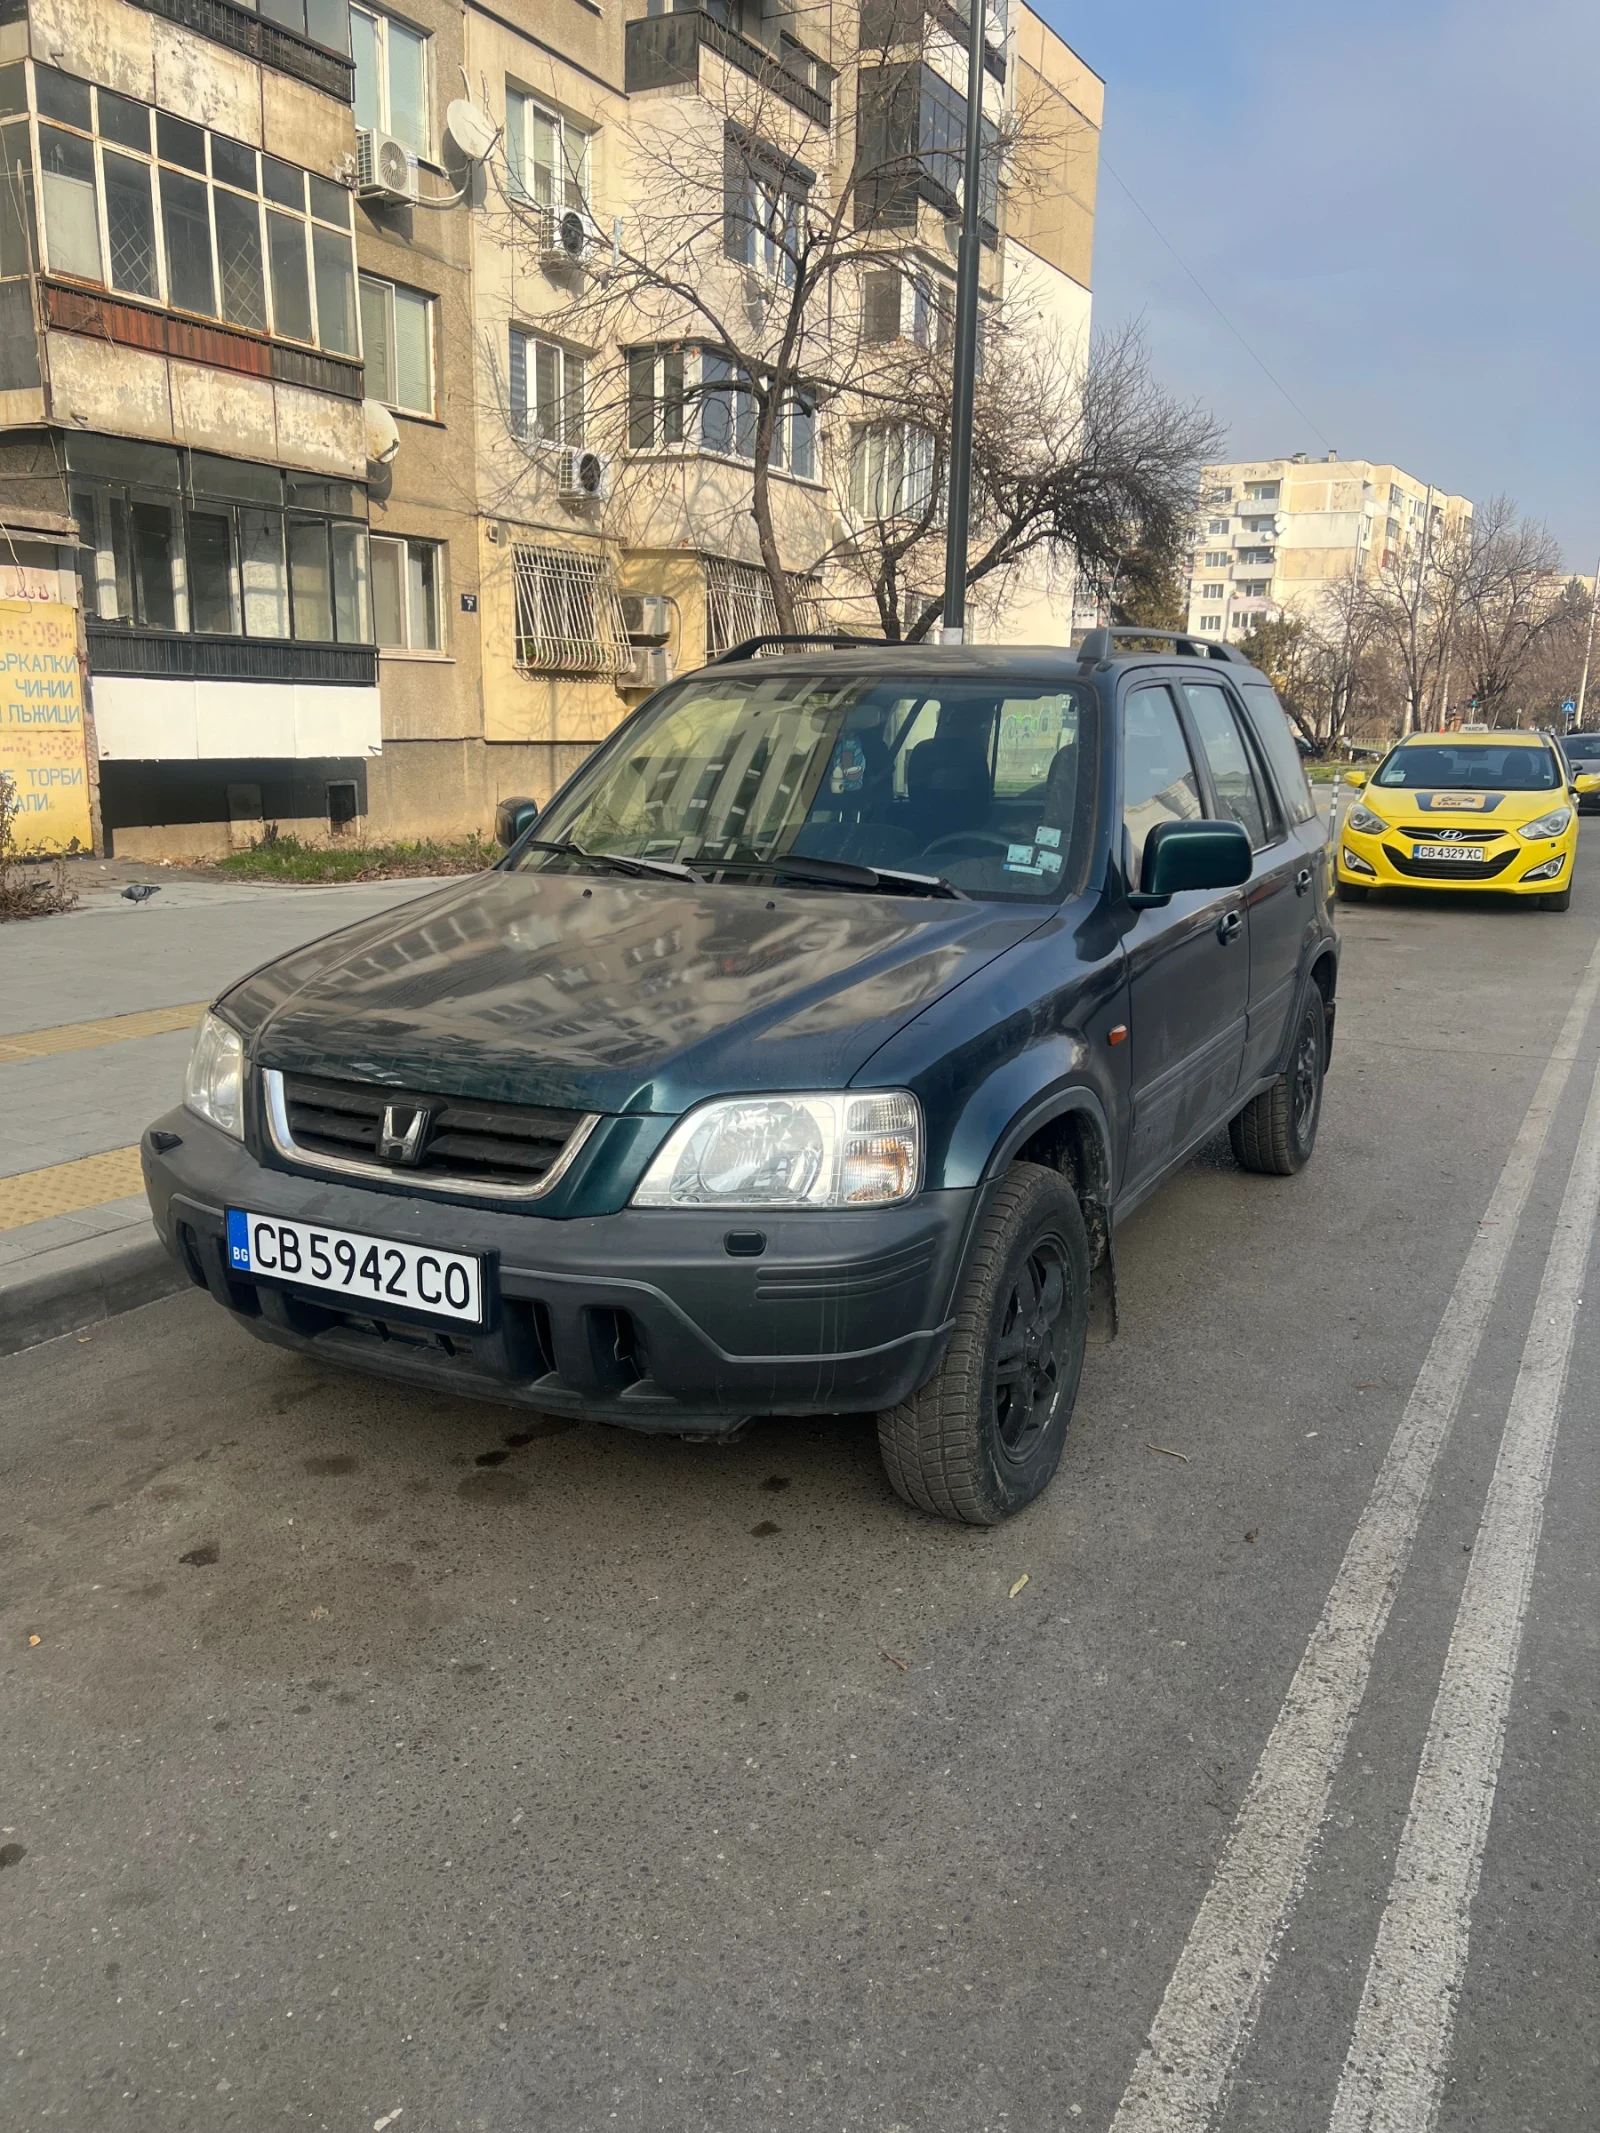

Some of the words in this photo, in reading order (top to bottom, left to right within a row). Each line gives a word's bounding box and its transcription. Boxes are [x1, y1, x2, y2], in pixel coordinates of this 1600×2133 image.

[15, 678, 75, 699] ЧИНИИ
[26, 767, 83, 787] ТОРБИ
[6, 793, 48, 812] АЛИ
[1437, 848, 1464, 859] 4329
[232, 1247, 248, 1262] BG
[310, 1233, 407, 1298] 5942
